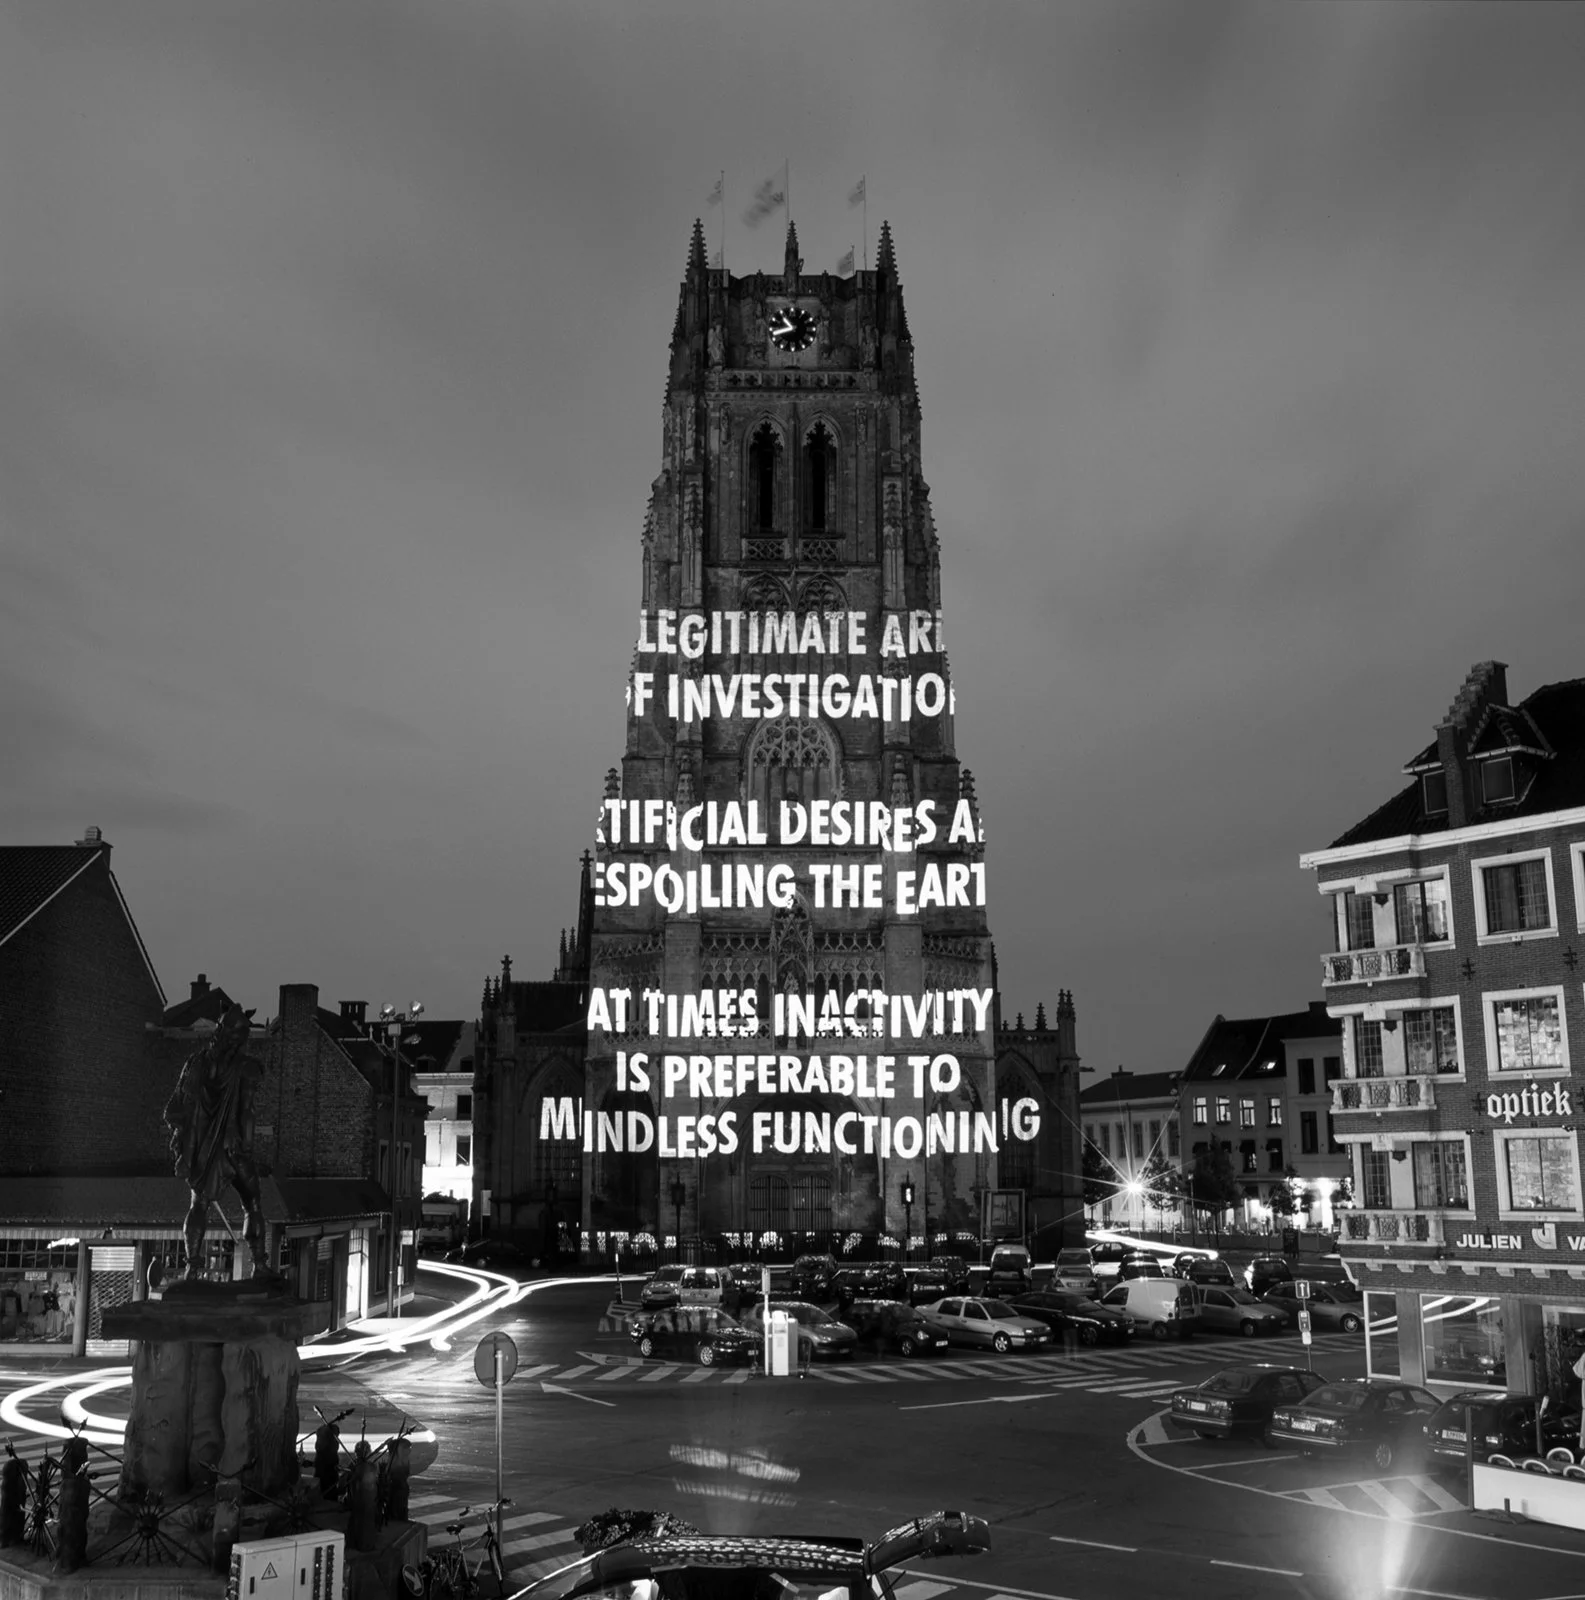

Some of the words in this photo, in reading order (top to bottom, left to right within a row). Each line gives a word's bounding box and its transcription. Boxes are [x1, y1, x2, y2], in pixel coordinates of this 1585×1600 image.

[637, 609, 867, 659] LEGITIMATE
[781, 800, 937, 852] DESIRES
[809, 864, 883, 908] THE
[587, 987, 631, 1032] AT
[643, 988, 759, 1037] TIMES
[774, 987, 993, 1037] INACTIVITY
[616, 1051, 651, 1092] IS
[665, 1056, 895, 1099] PREFERABLE
[908, 1053, 961, 1098] TO
[1486, 1081, 1573, 1125] optiek
[539, 1097, 739, 1158] MINDLESS
[753, 1097, 1041, 1159] FUNCTIONING
[1456, 1233, 1522, 1250] JULIEN
